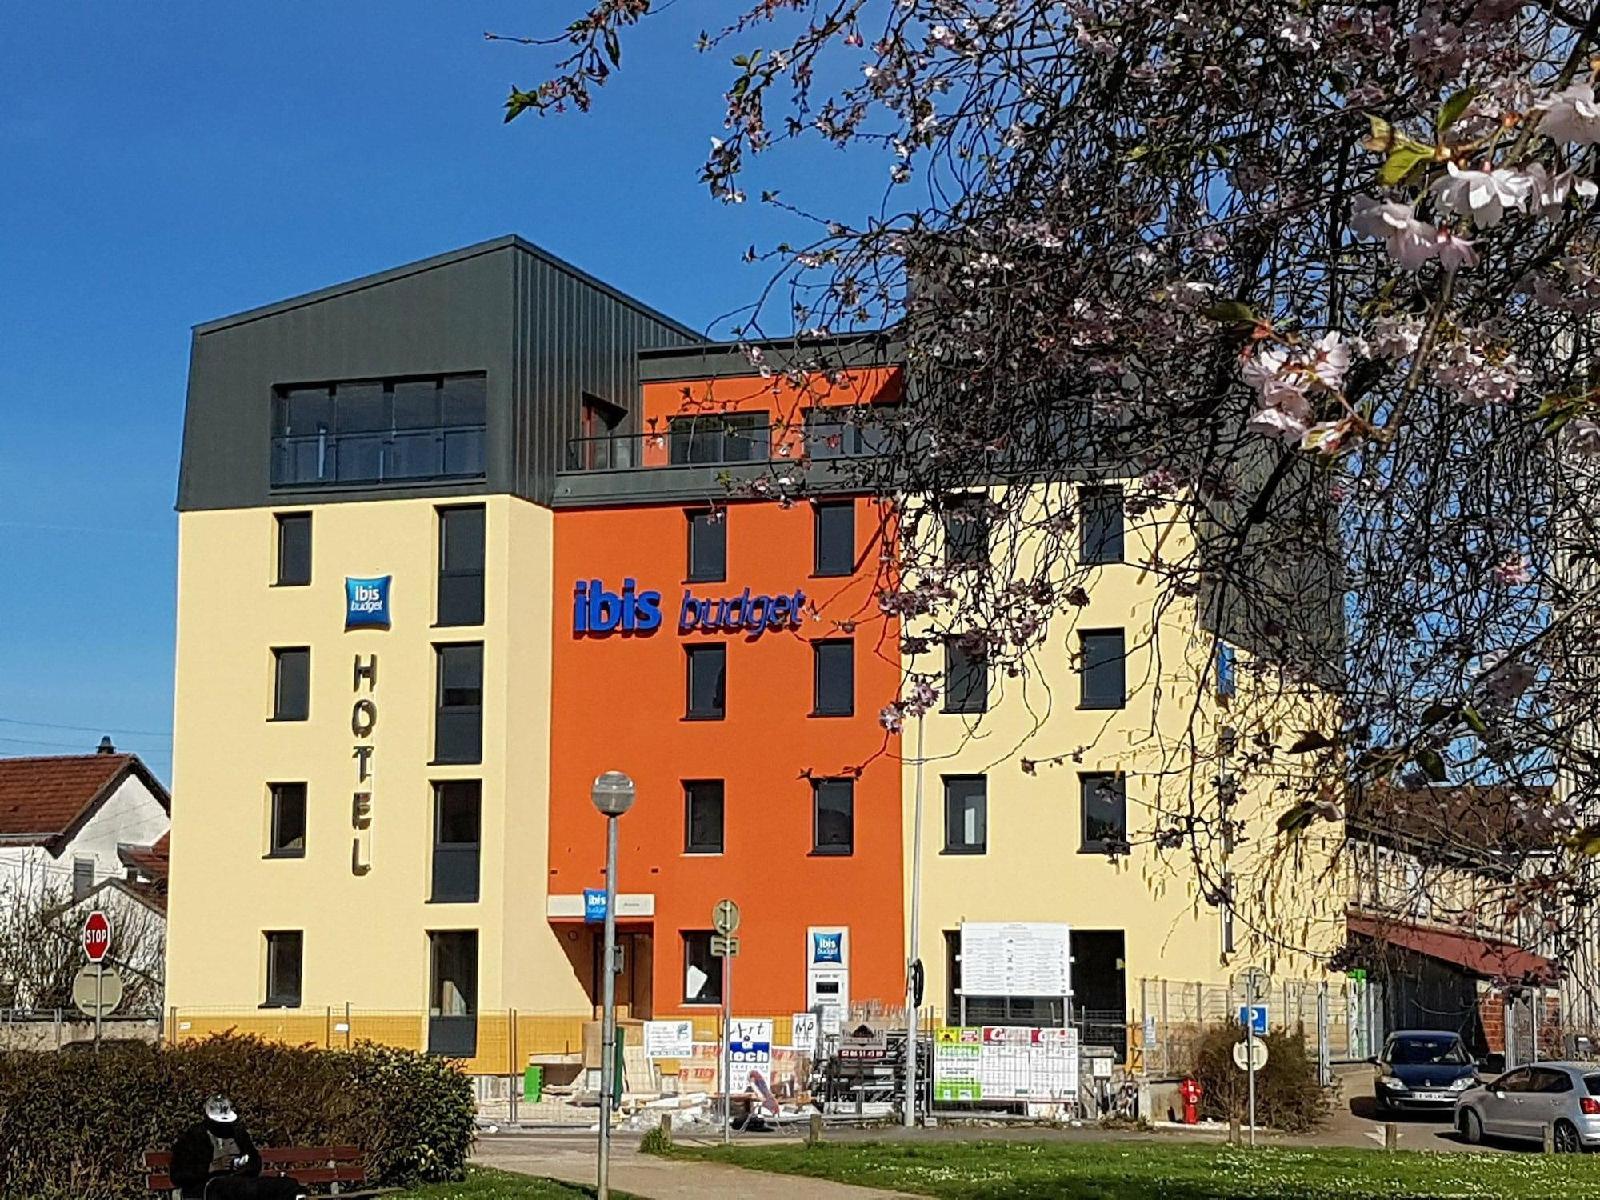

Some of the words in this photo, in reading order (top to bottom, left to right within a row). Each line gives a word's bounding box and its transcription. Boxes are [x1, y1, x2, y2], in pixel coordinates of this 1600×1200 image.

[355, 585, 380, 601] ibis
[350, 600, 383, 614] budget
[573, 578, 662, 634] ibis
[680, 587, 806, 637] budget
[352, 654, 377, 876] HOTEL
[86, 929, 107, 943] STOP
